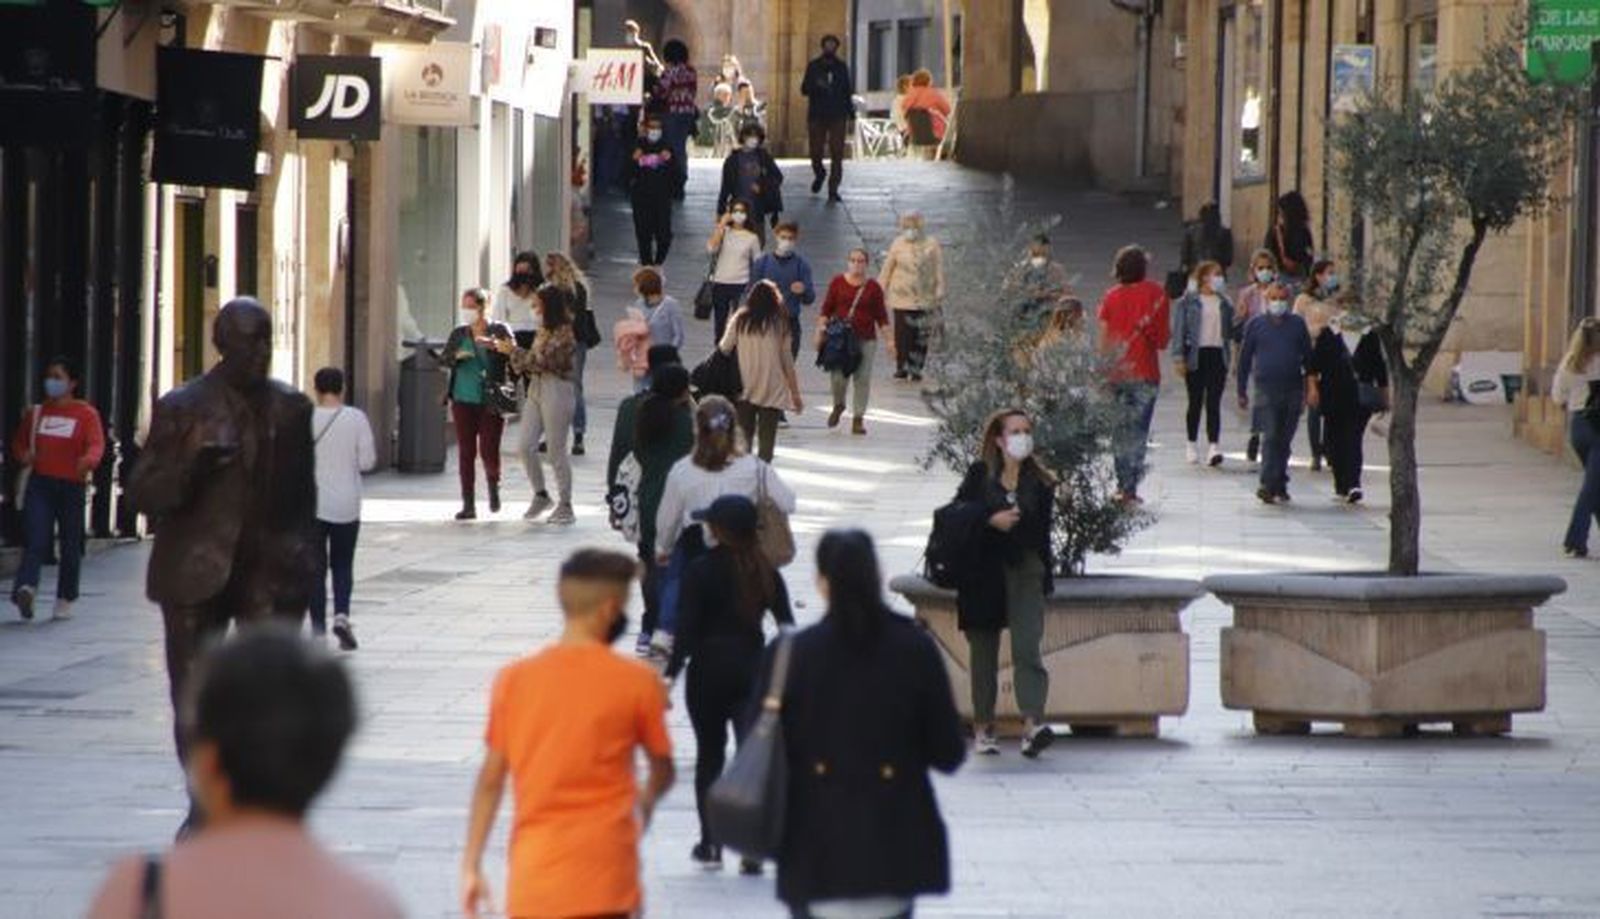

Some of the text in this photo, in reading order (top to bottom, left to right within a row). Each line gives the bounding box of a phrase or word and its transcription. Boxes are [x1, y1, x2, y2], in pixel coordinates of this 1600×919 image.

[1566, 9, 1599, 26] LAS
[593, 61, 636, 91] H&M
[305, 74, 370, 119] JD
